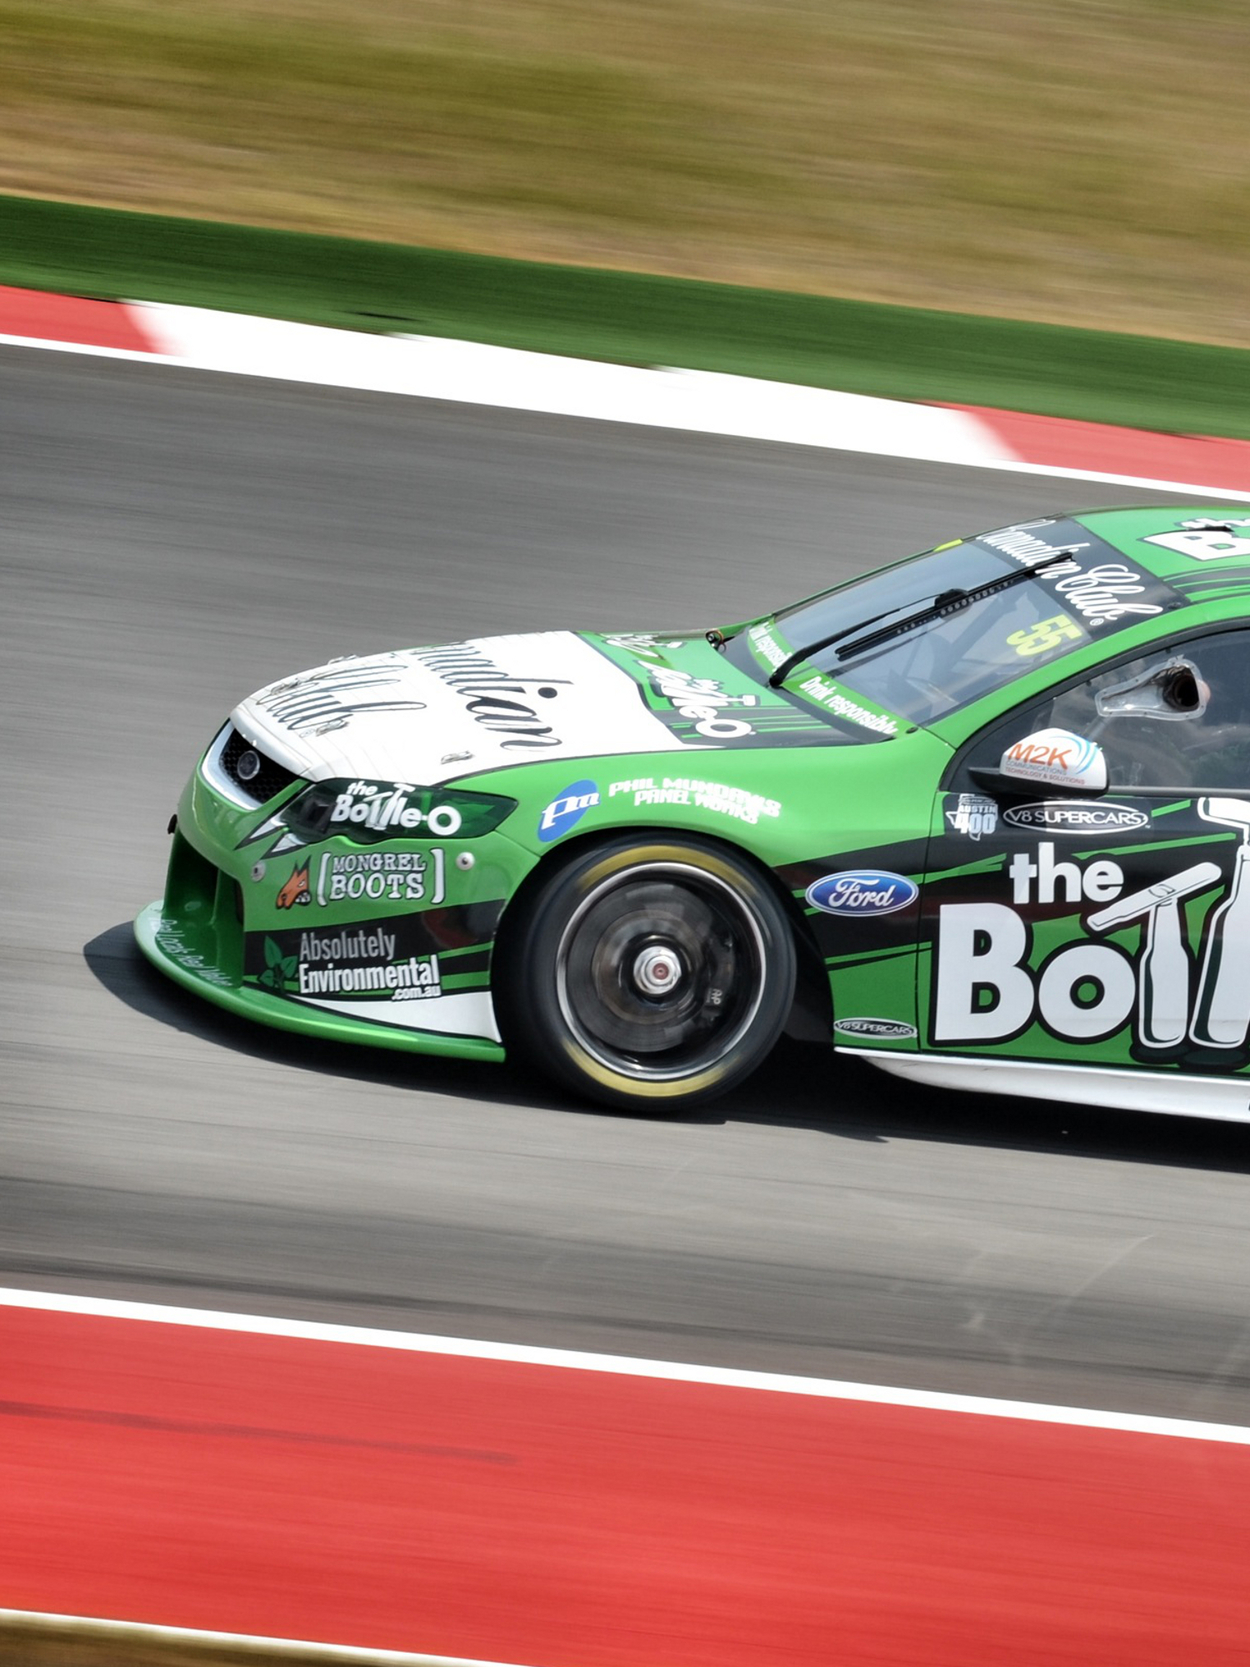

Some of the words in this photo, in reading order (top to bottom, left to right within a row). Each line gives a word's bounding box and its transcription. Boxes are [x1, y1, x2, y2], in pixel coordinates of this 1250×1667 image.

[975, 518, 1091, 579] Canadin
[1054, 564, 1164, 620] Club
[1006, 614, 1083, 656] 55
[408, 641, 575, 751] nadian
[799, 676, 837, 701] Drink
[1007, 743, 1072, 770] M2K
[347, 781, 378, 796] the
[609, 778, 658, 797] PHIL
[954, 813, 997, 834] 400
[1009, 810, 1031, 823] V8
[1034, 810, 1142, 826] SUPERCARS
[332, 853, 427, 872] MONGREL
[1009, 842, 1124, 905] the
[330, 873, 425, 900] BOOTS
[828, 878, 896, 907] Ford
[300, 927, 396, 961] Absolutely
[299, 954, 440, 994] Environmental
[391, 985, 442, 1000] .com.au
[852, 1022, 912, 1035] SUPERCARS
